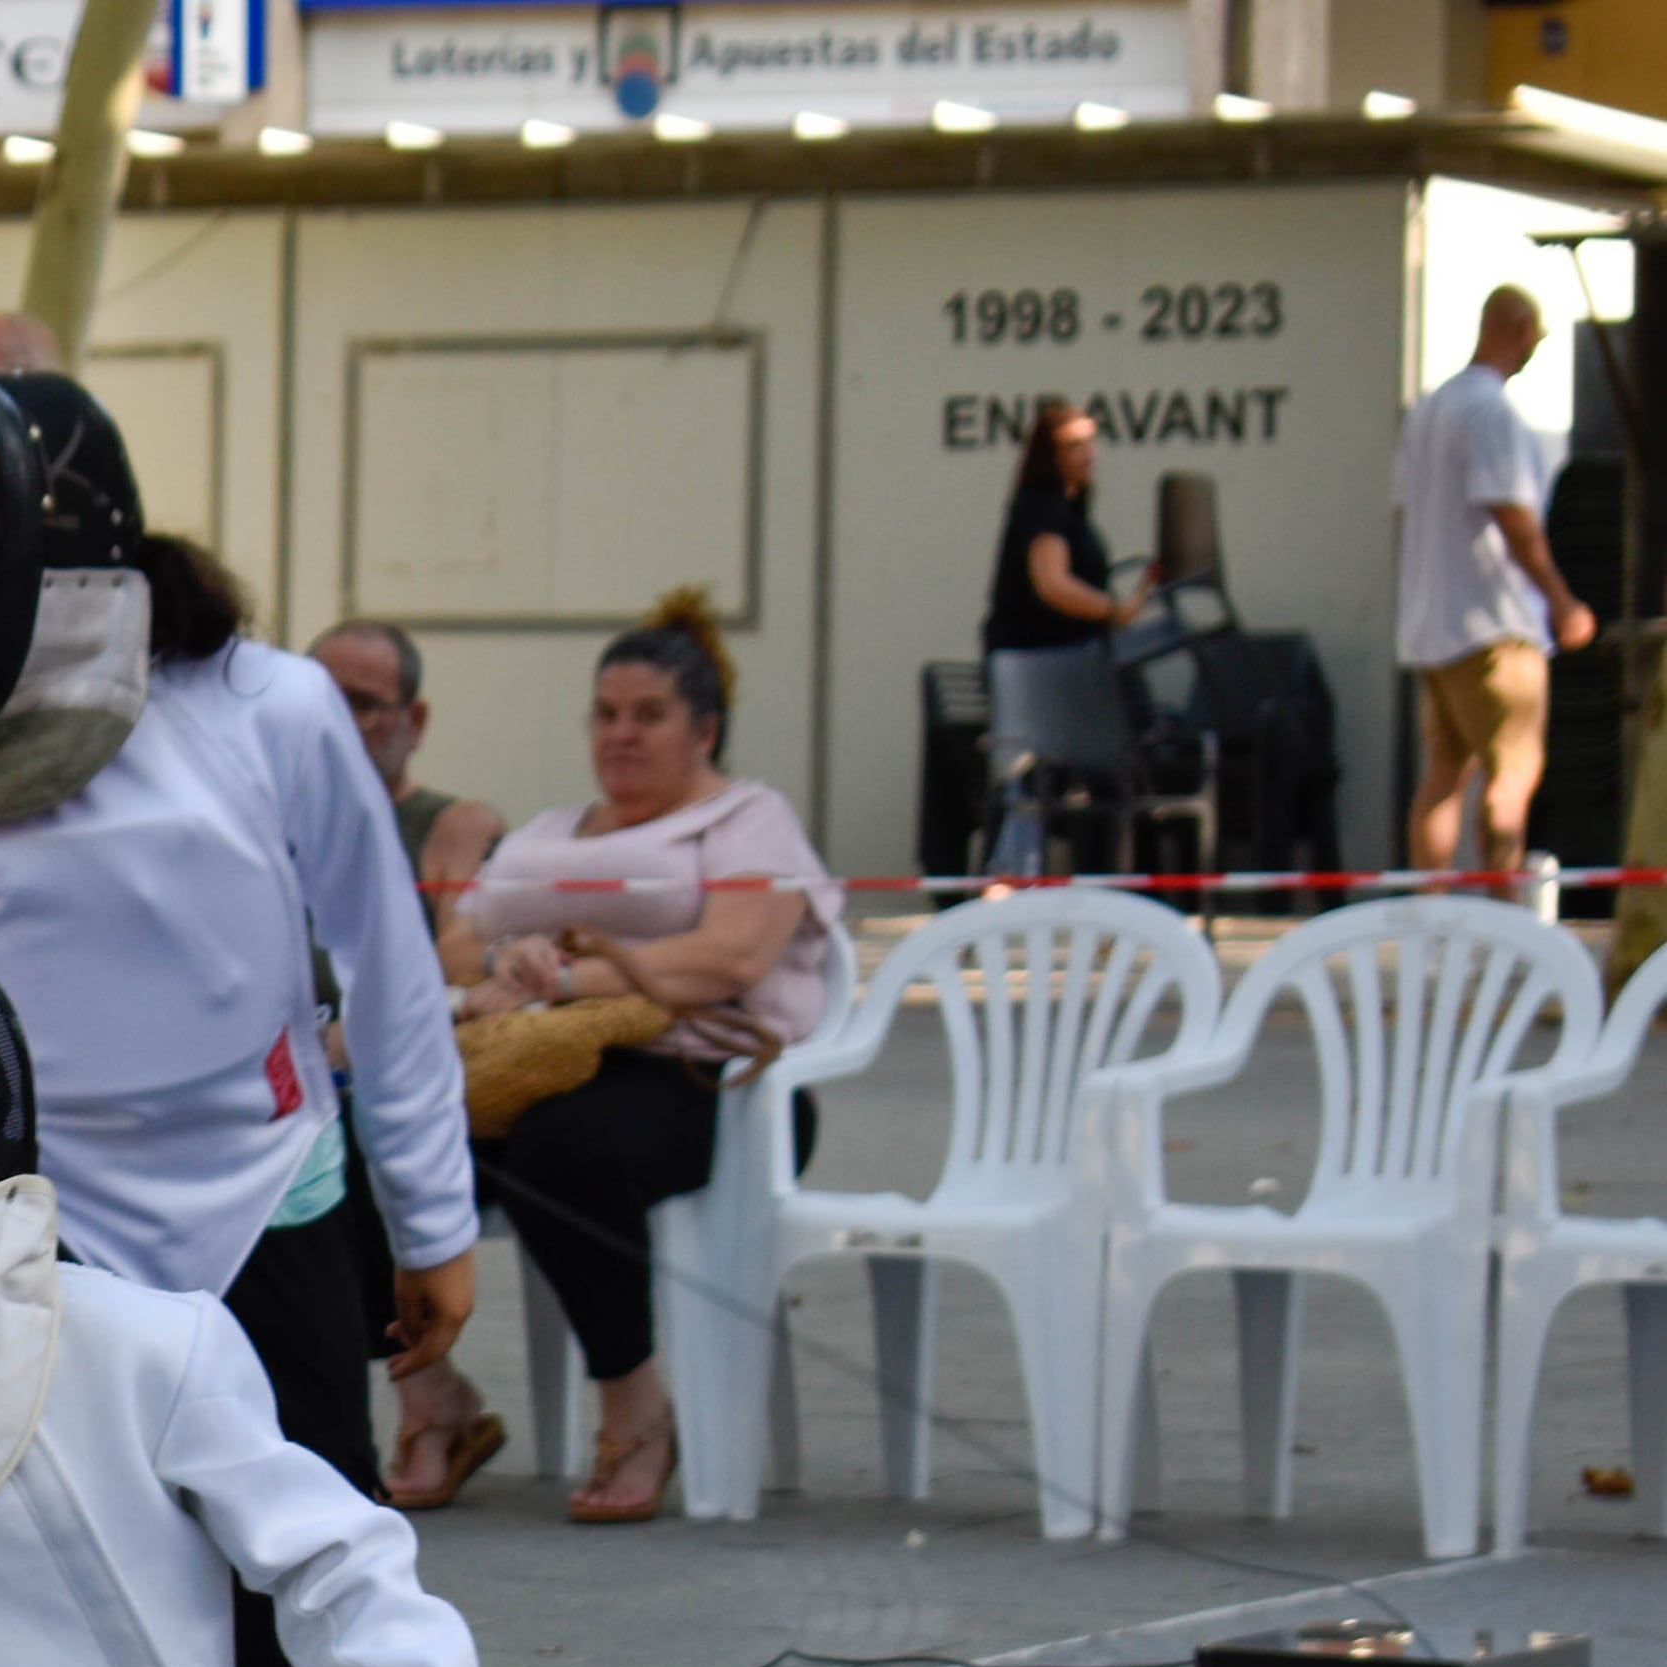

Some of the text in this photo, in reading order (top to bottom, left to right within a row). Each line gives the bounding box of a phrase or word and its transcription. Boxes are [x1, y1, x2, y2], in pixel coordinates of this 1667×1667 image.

[688, 30, 879, 76] Apuestas
[896, 21, 958, 65] del
[971, 17, 1121, 64] Estado
[945, 288, 1080, 344] 1998
[1140, 281, 1282, 341] 2023
[944, 385, 1287, 450] ENAVANT
